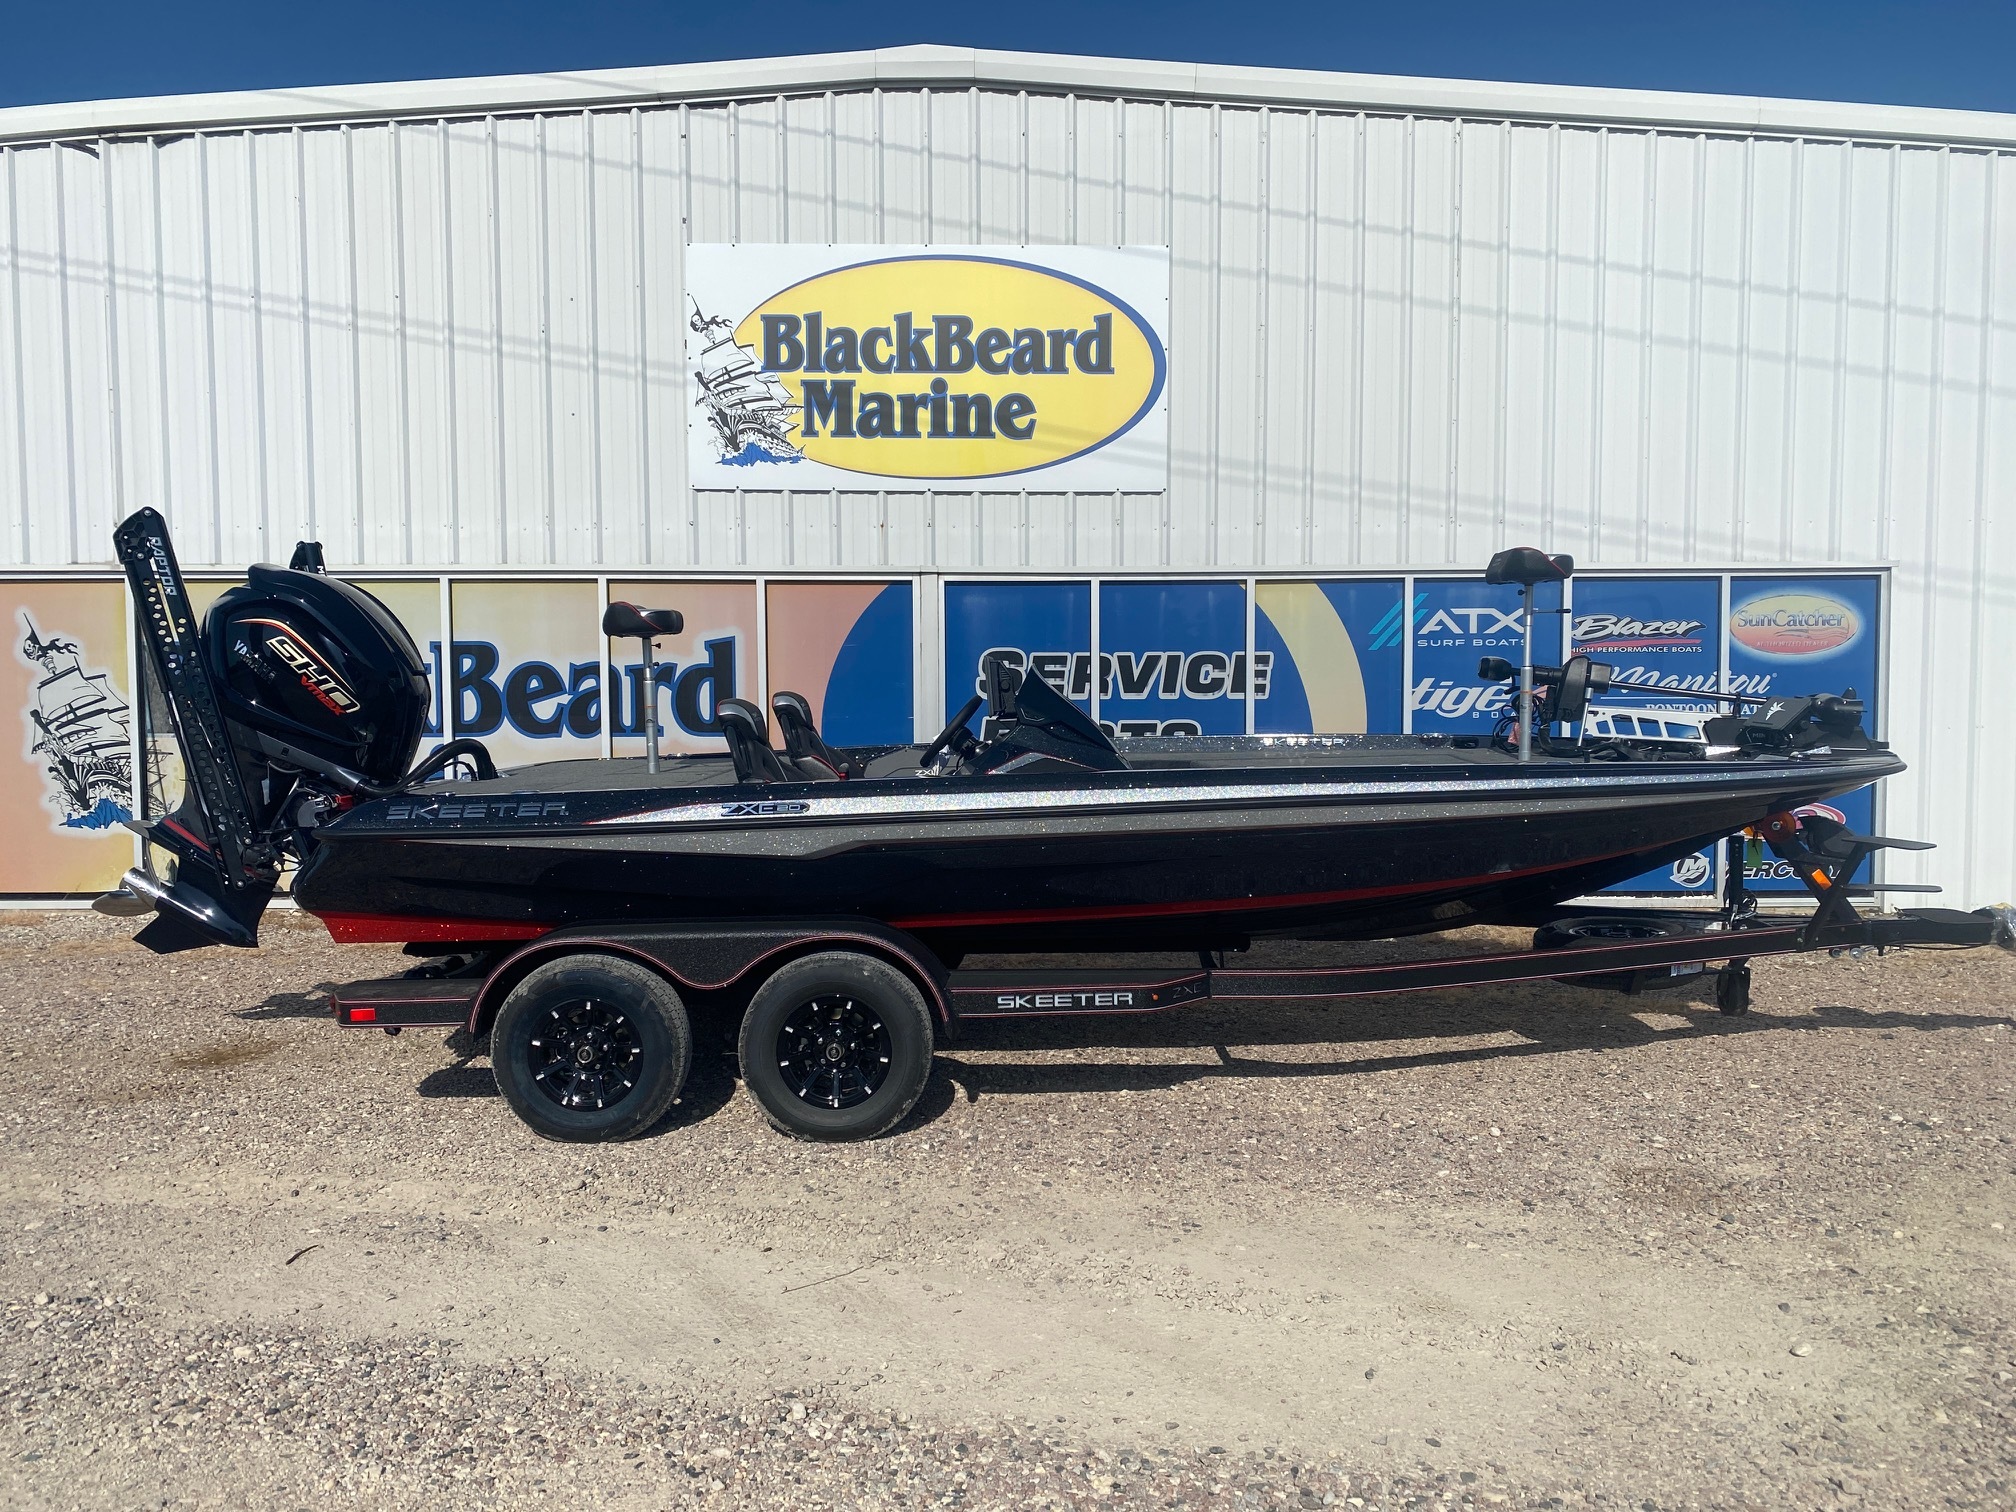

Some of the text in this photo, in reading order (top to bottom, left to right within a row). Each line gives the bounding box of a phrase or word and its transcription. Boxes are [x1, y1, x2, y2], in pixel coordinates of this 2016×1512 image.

[760, 312, 1115, 375] BlackBeard
[800, 378, 1037, 440] Marine
[148, 536, 177, 596] RAPTOR
[1418, 608, 1538, 635] ATX
[1572, 613, 1706, 641] Blazer
[1737, 609, 1846, 628] SunCatcher
[1417, 639, 1466, 647] SURF
[975, 647, 1274, 700] SERVICE
[386, 802, 569, 820] SKEETER
[997, 992, 1133, 1009] SKEETER
